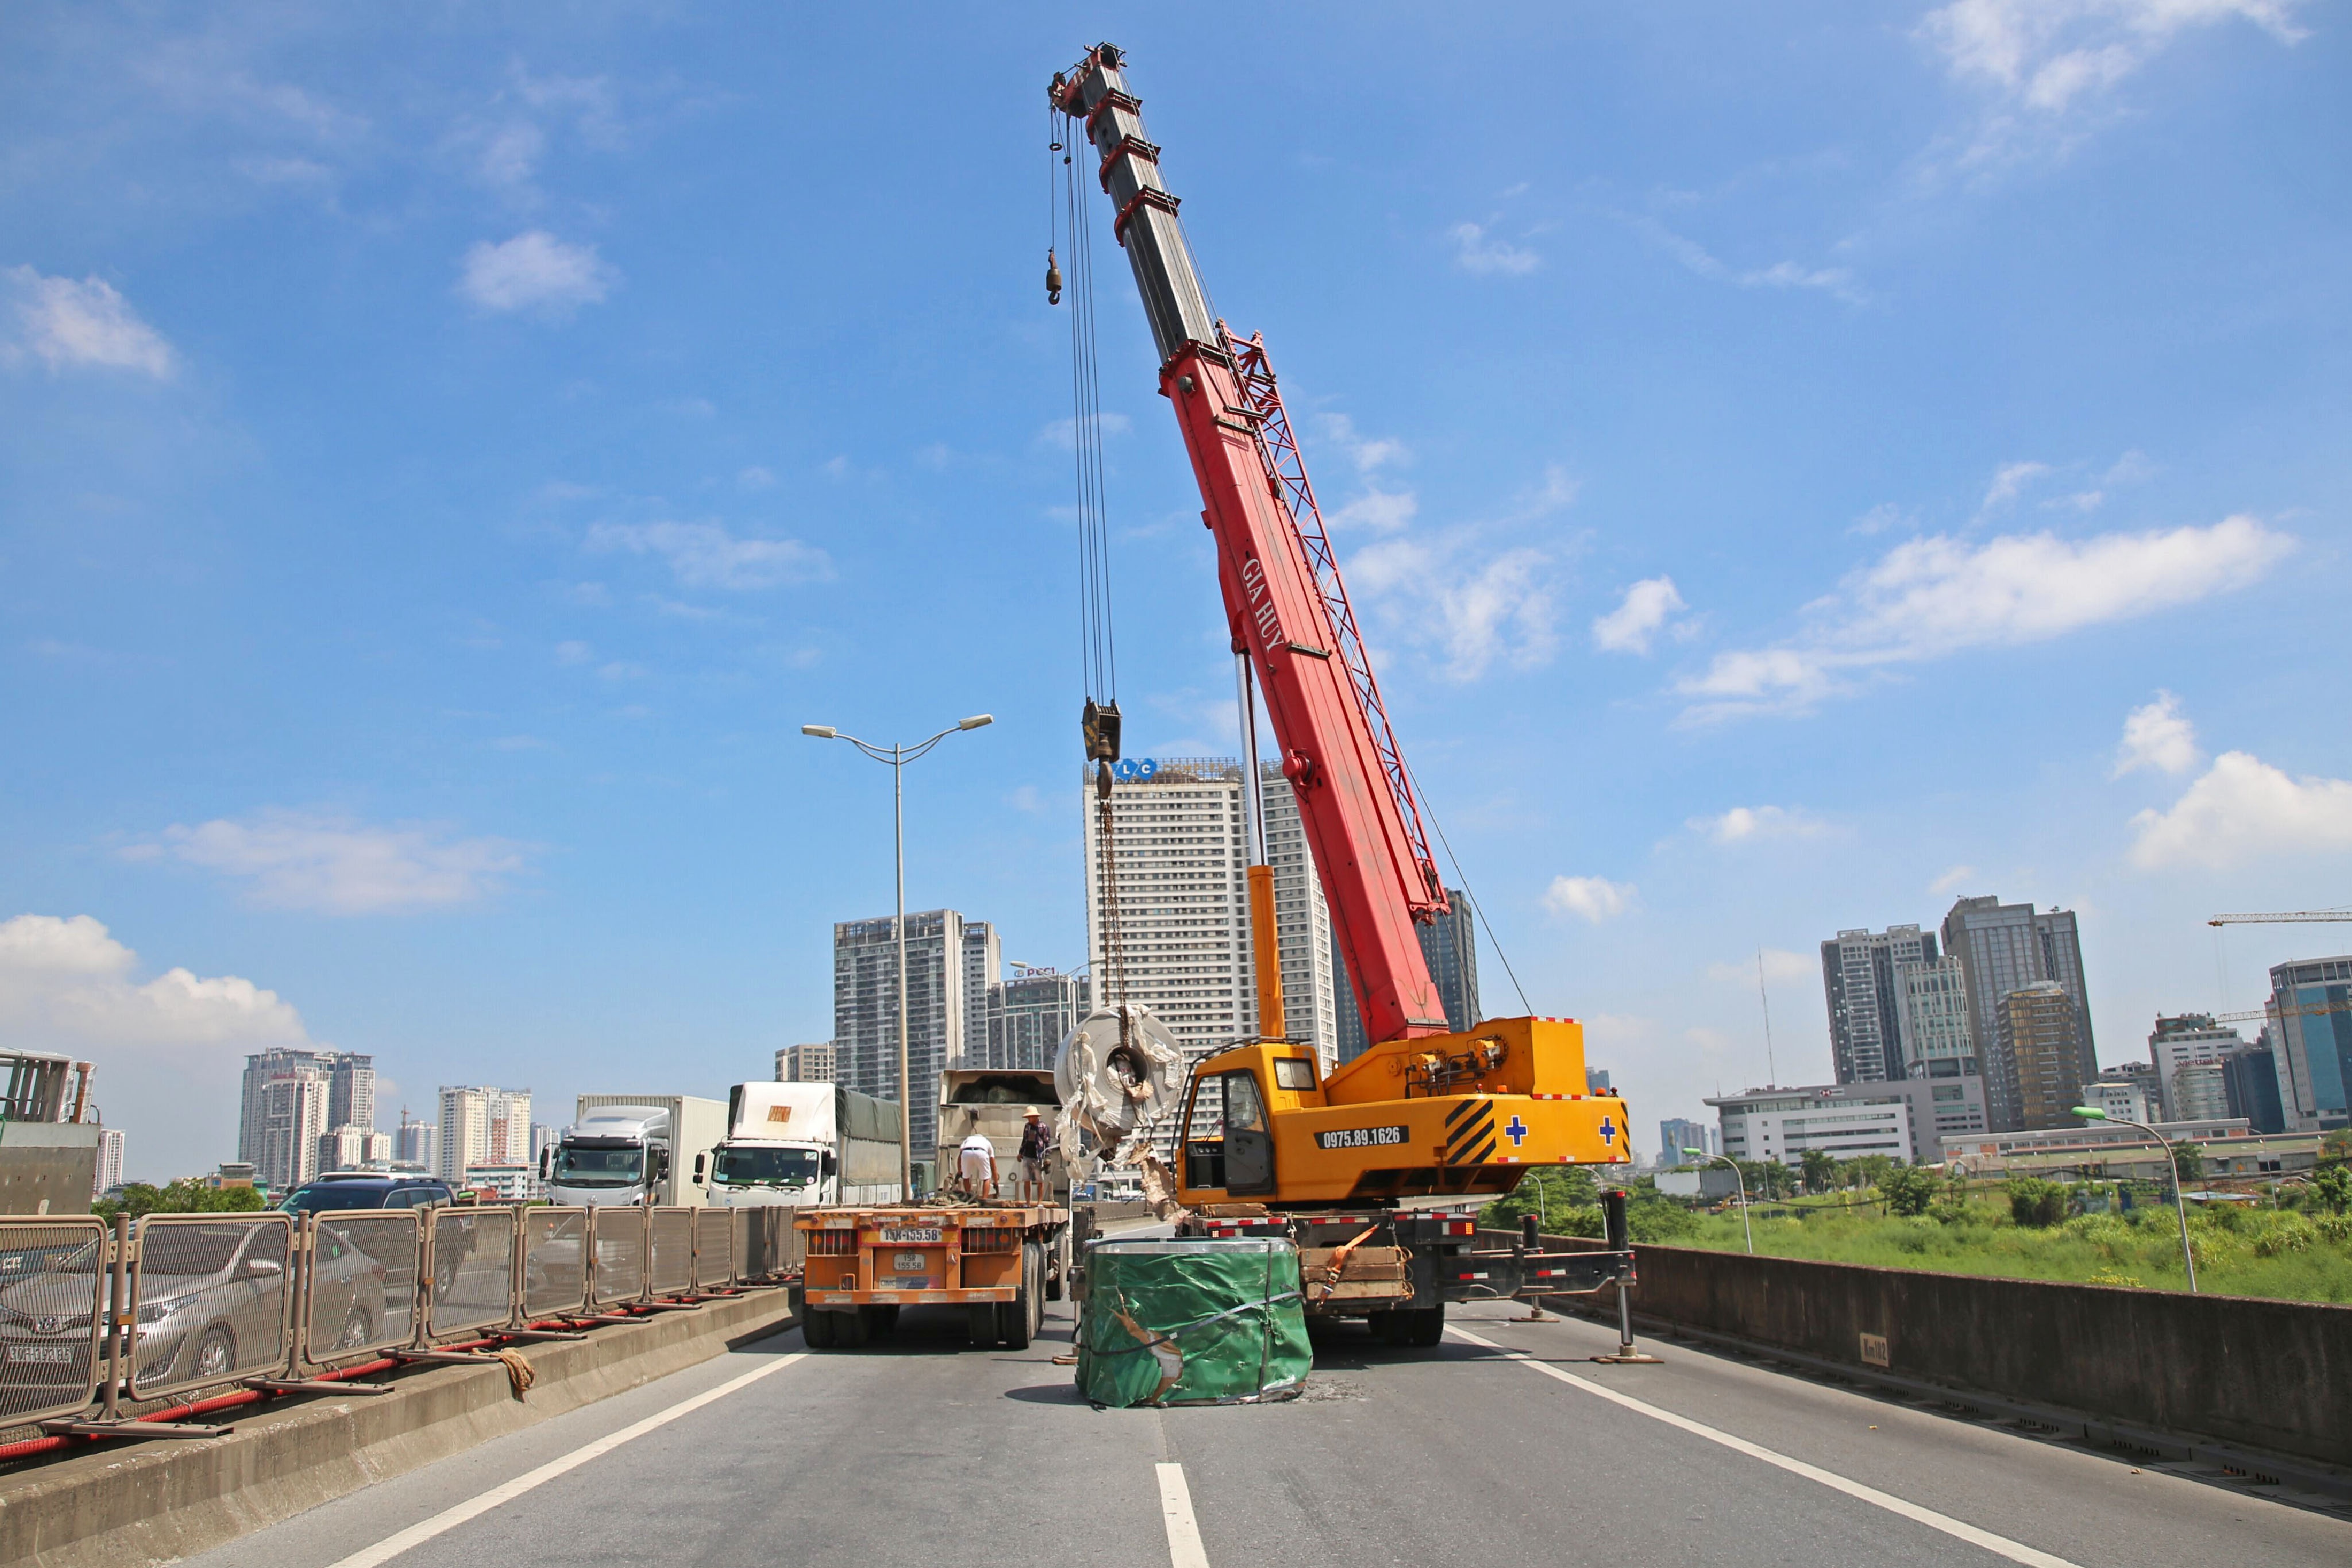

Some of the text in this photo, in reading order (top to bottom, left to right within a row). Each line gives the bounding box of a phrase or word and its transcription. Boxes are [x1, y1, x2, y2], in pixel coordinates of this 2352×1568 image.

[1243, 558, 1284, 653] GIA HUY
[1323, 1126, 1400, 1149] 0975.89.1626
